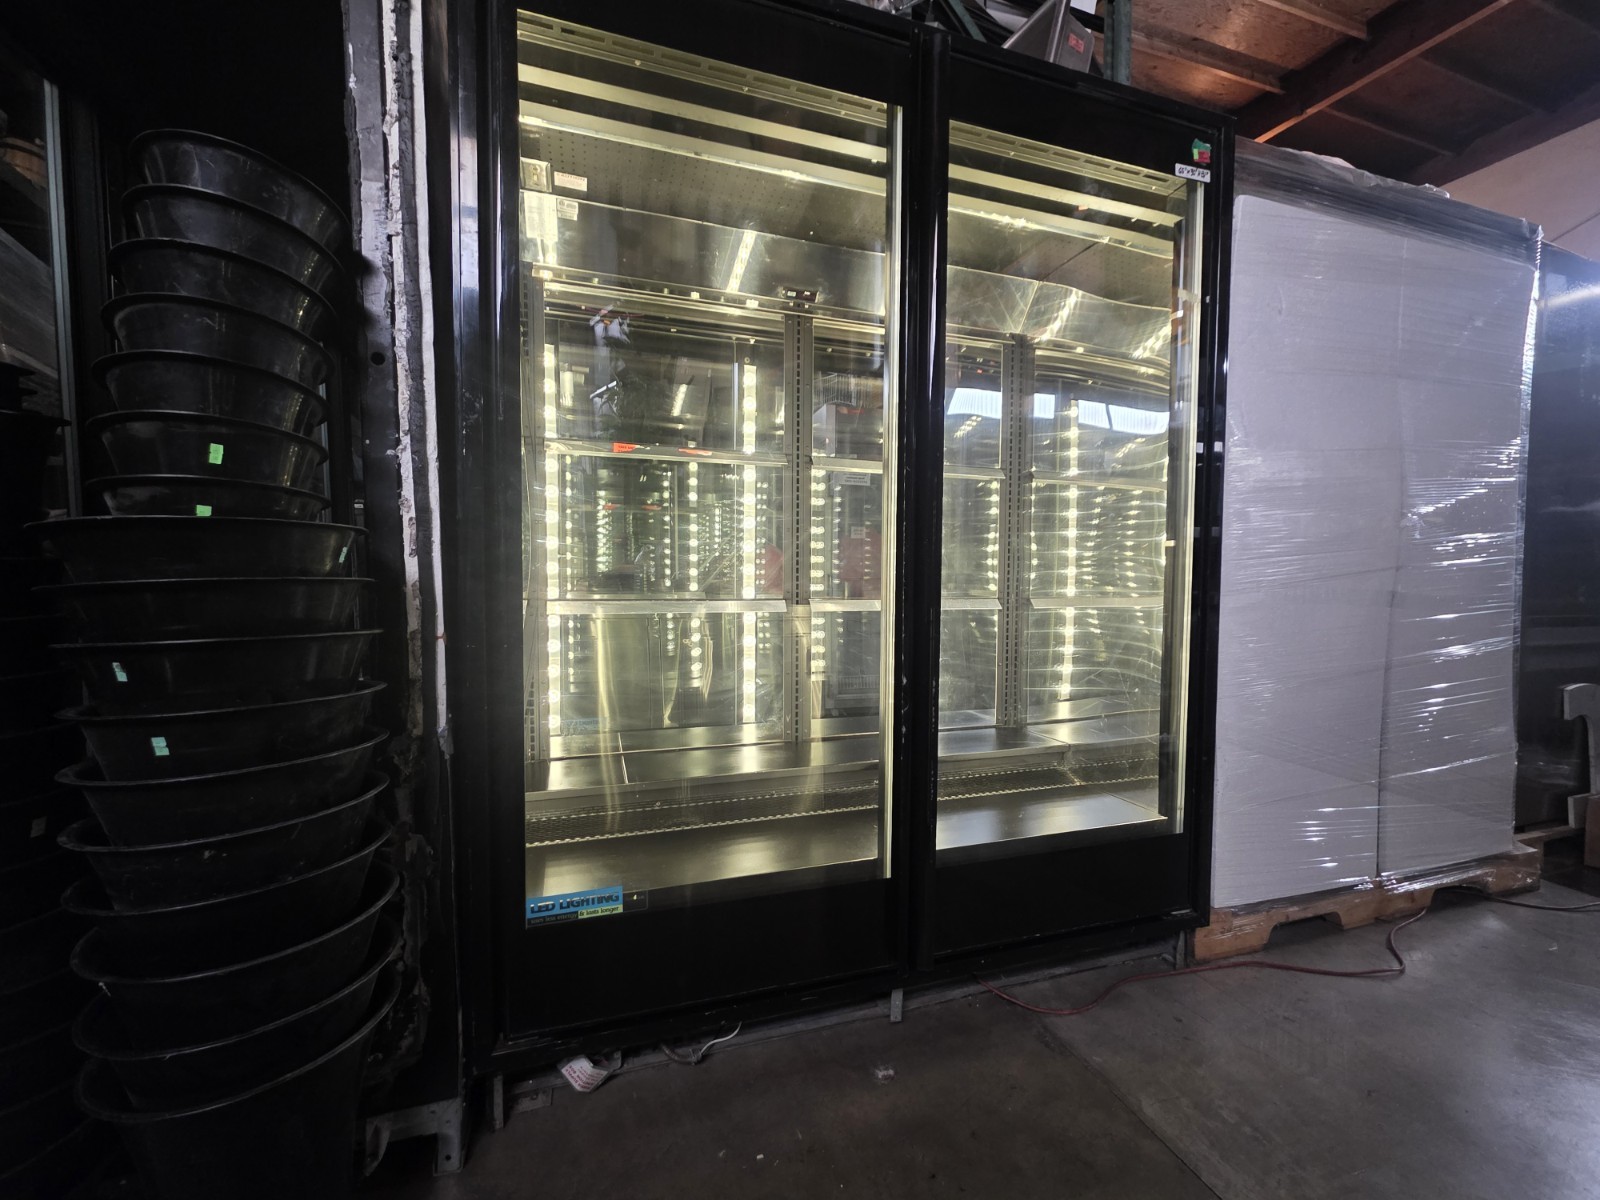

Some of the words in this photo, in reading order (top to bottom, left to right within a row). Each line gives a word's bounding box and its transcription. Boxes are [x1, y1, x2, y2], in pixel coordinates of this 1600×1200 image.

[530, 901, 556, 914] LED
[559, 893, 620, 910] LIGHTING
[557, 913, 578, 921] energy
[600, 906, 619, 914] longer
